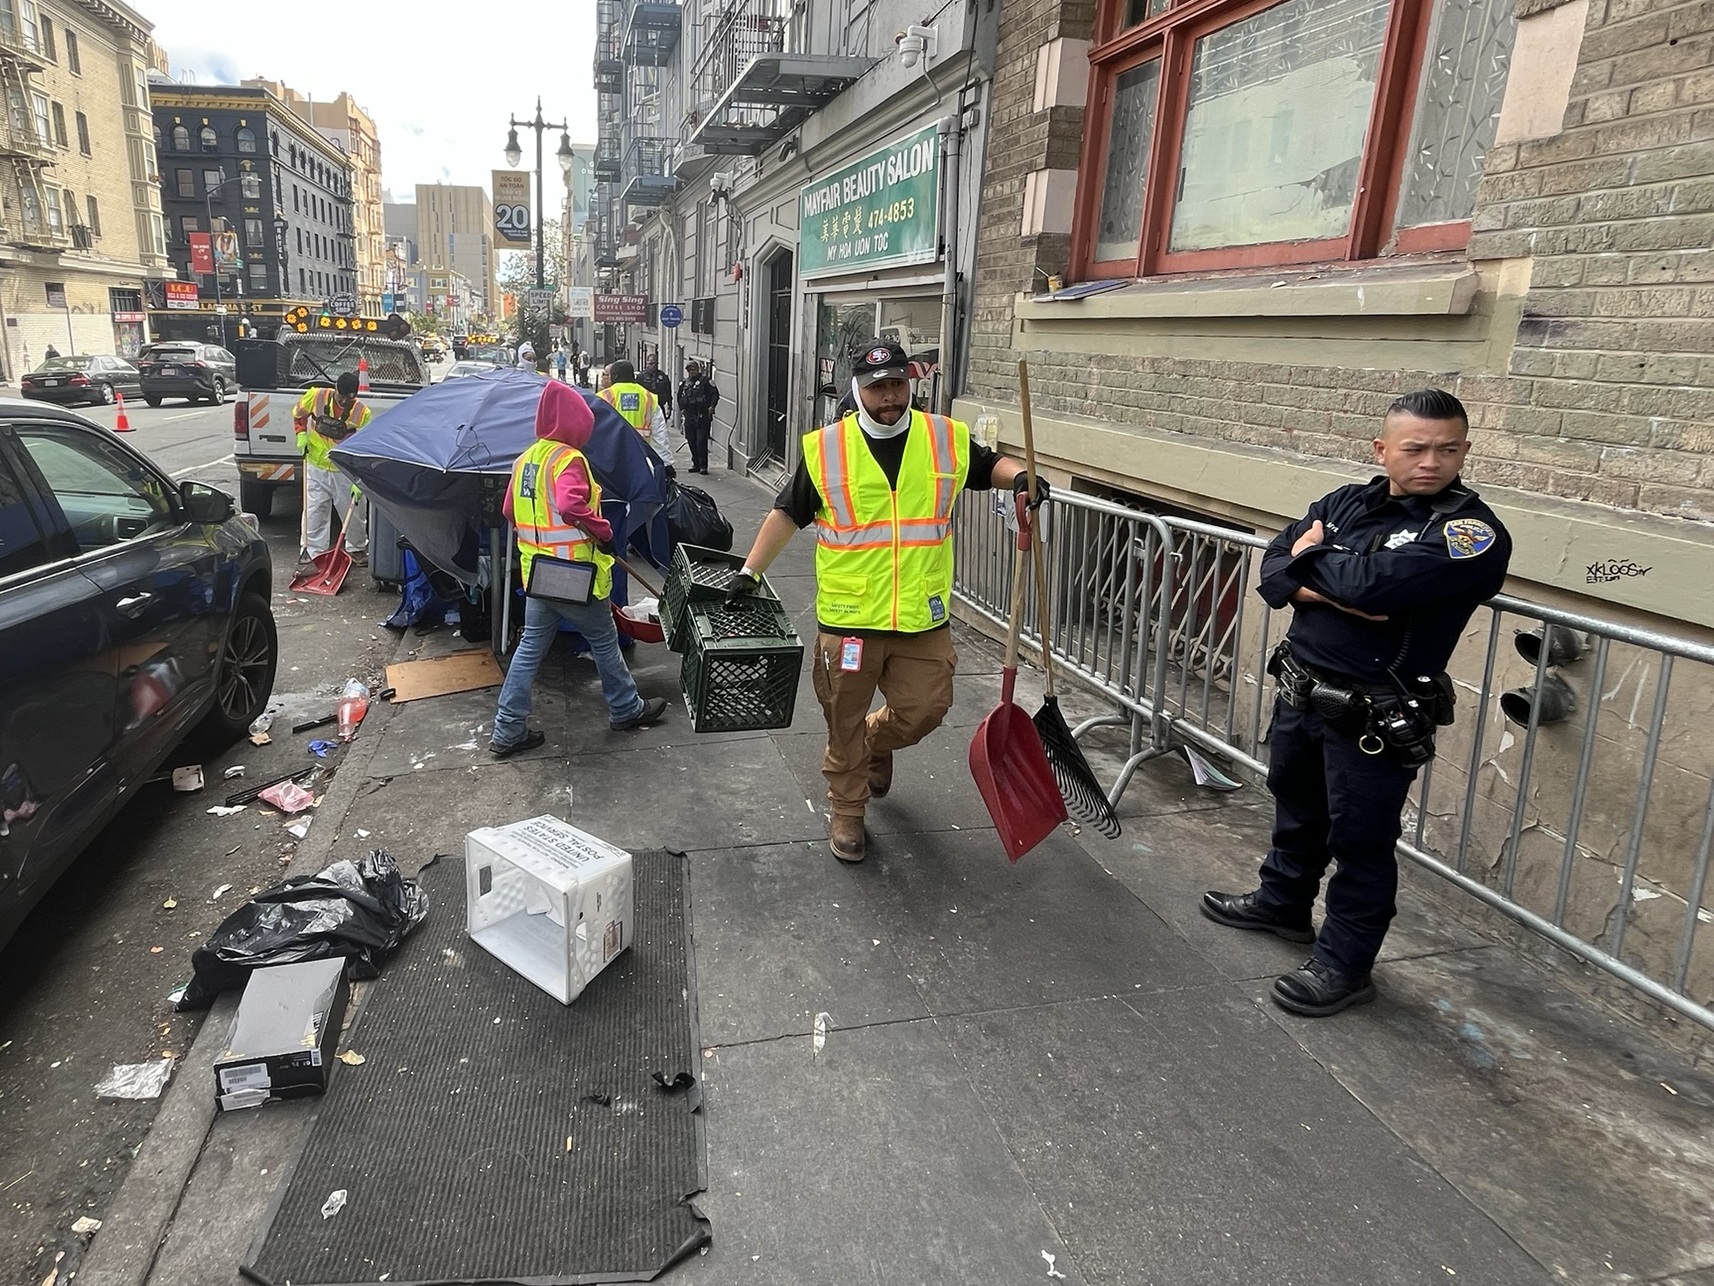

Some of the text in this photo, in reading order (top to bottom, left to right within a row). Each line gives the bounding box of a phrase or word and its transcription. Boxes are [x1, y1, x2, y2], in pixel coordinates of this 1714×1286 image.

[804, 137, 935, 218] MAYFAIR BEAUTY SALON
[496, 204, 529, 229] 20
[826, 246, 837, 262] MY
[598, 296, 620, 304] Sing
[622, 296, 644, 305] Sing
[523, 825, 558, 844] STATES
[530, 821, 569, 839] SERVICE
[555, 842, 590, 863] UNITED
[568, 838, 605, 860] POSTAL
